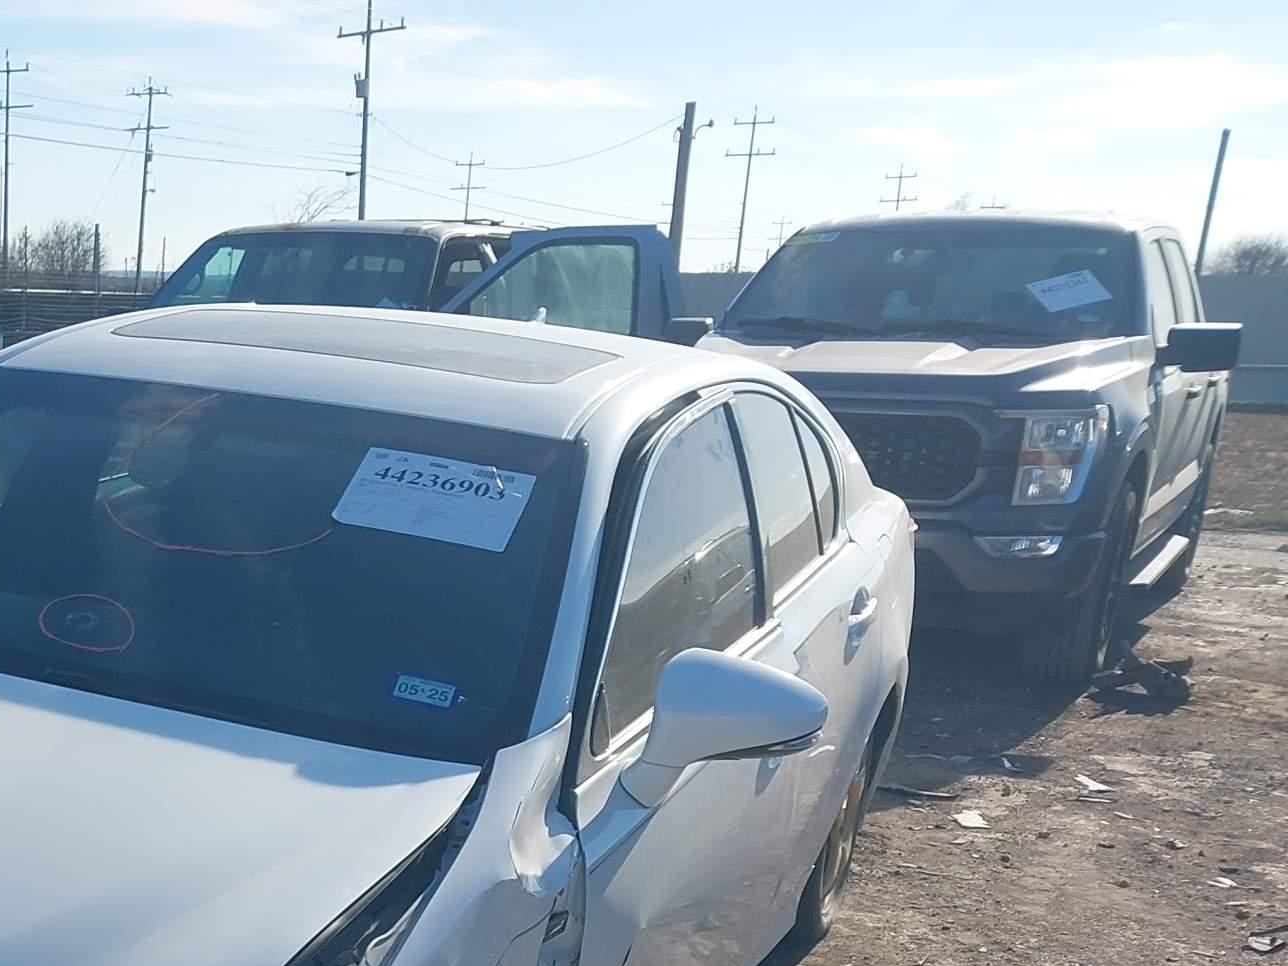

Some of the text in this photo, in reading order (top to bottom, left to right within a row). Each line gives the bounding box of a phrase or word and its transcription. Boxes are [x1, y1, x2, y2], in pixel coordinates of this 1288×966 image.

[374, 466, 505, 500] 44236903
[398, 682, 449, 702] 05 25
